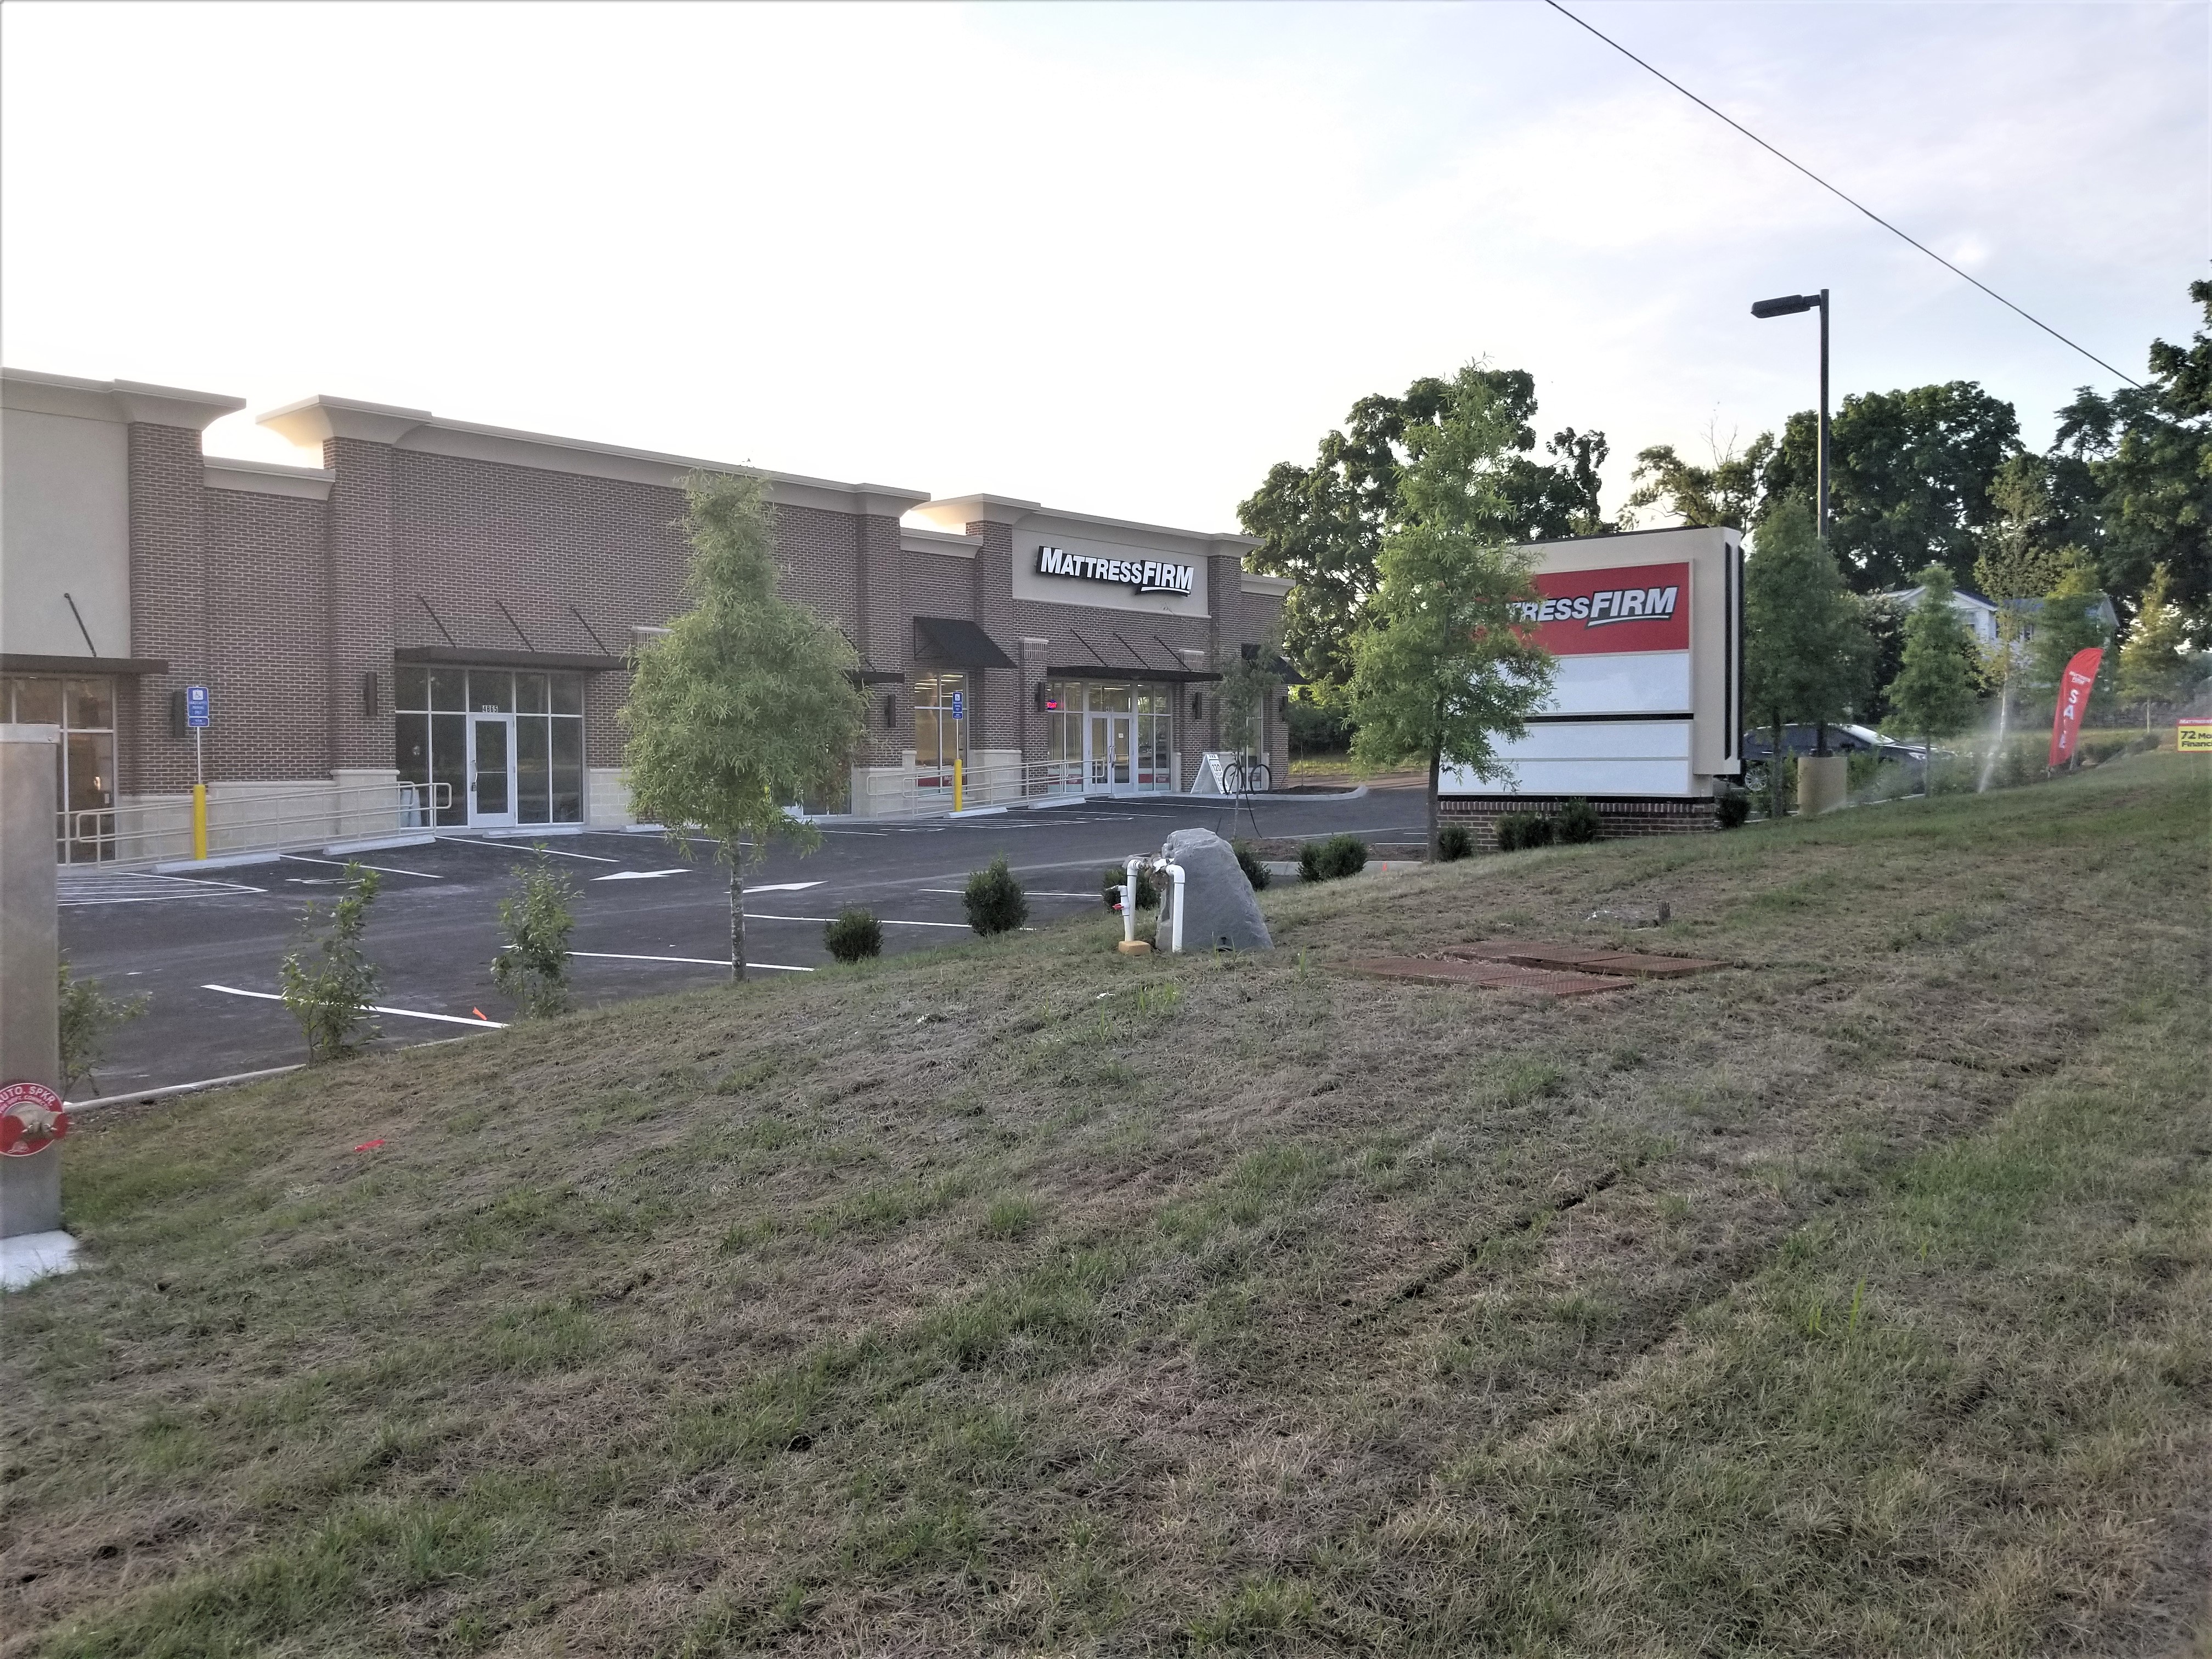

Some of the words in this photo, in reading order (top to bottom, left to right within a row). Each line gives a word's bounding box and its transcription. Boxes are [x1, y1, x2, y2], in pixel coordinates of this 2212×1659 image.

[1041, 547, 1194, 590] MATTRESSFIRM
[1506, 586, 1678, 623] TRESSFIRM
[2181, 731, 2196, 739] 72
[1212, 764, 1221, 772] 120
[29, 1086, 55, 1106] SPKR.
